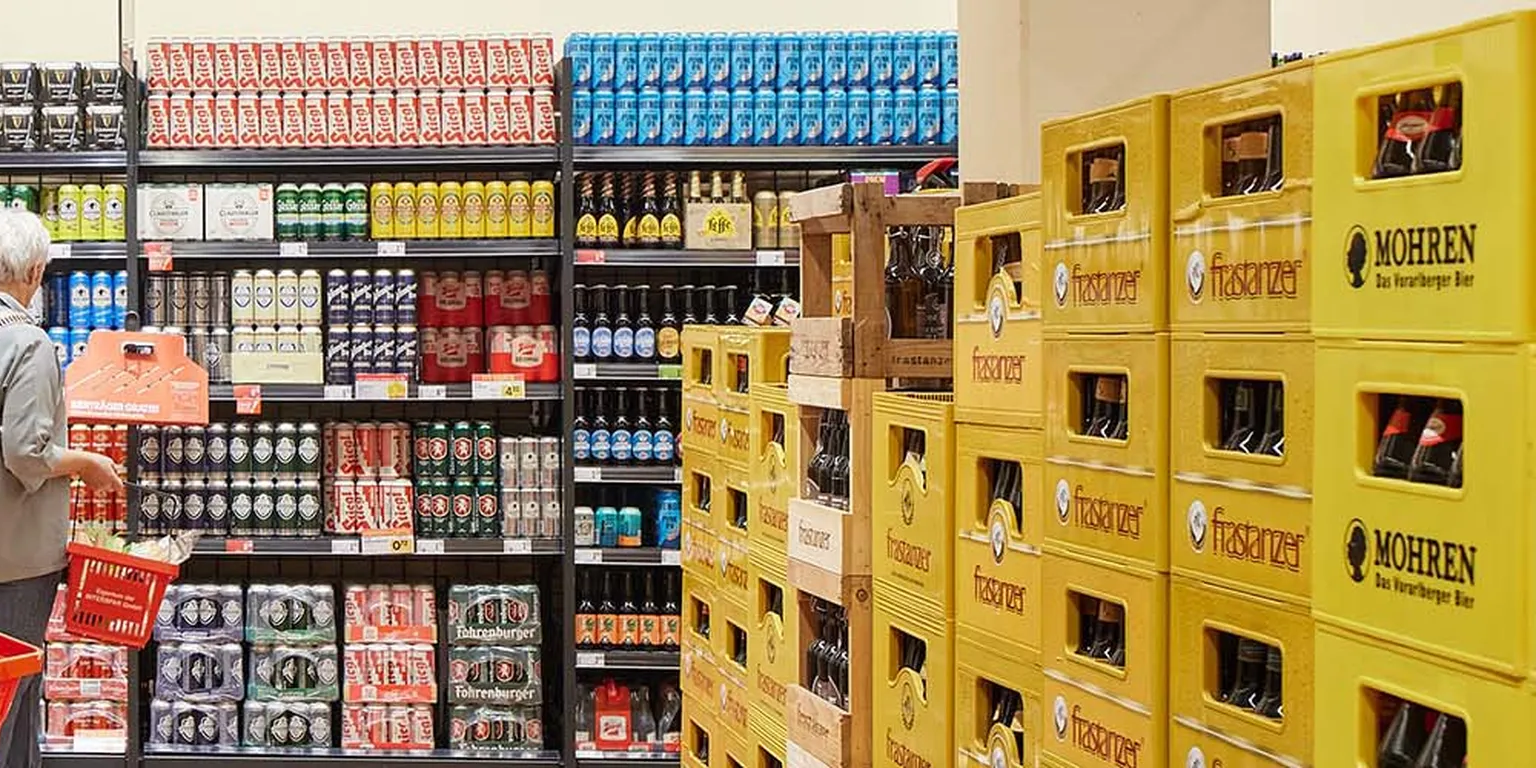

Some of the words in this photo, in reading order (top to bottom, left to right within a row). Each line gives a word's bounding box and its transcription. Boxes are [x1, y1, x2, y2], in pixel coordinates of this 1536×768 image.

[1375, 224, 1477, 267] MOHREN
[1210, 252, 1304, 301] frastanzer
[1375, 273, 1391, 289] Das
[1393, 272, 1452, 291] Vorarlberger
[1454, 270, 1475, 288] Bier
[1211, 507, 1305, 572] frastanzer
[1374, 528, 1478, 587] MOHREN
